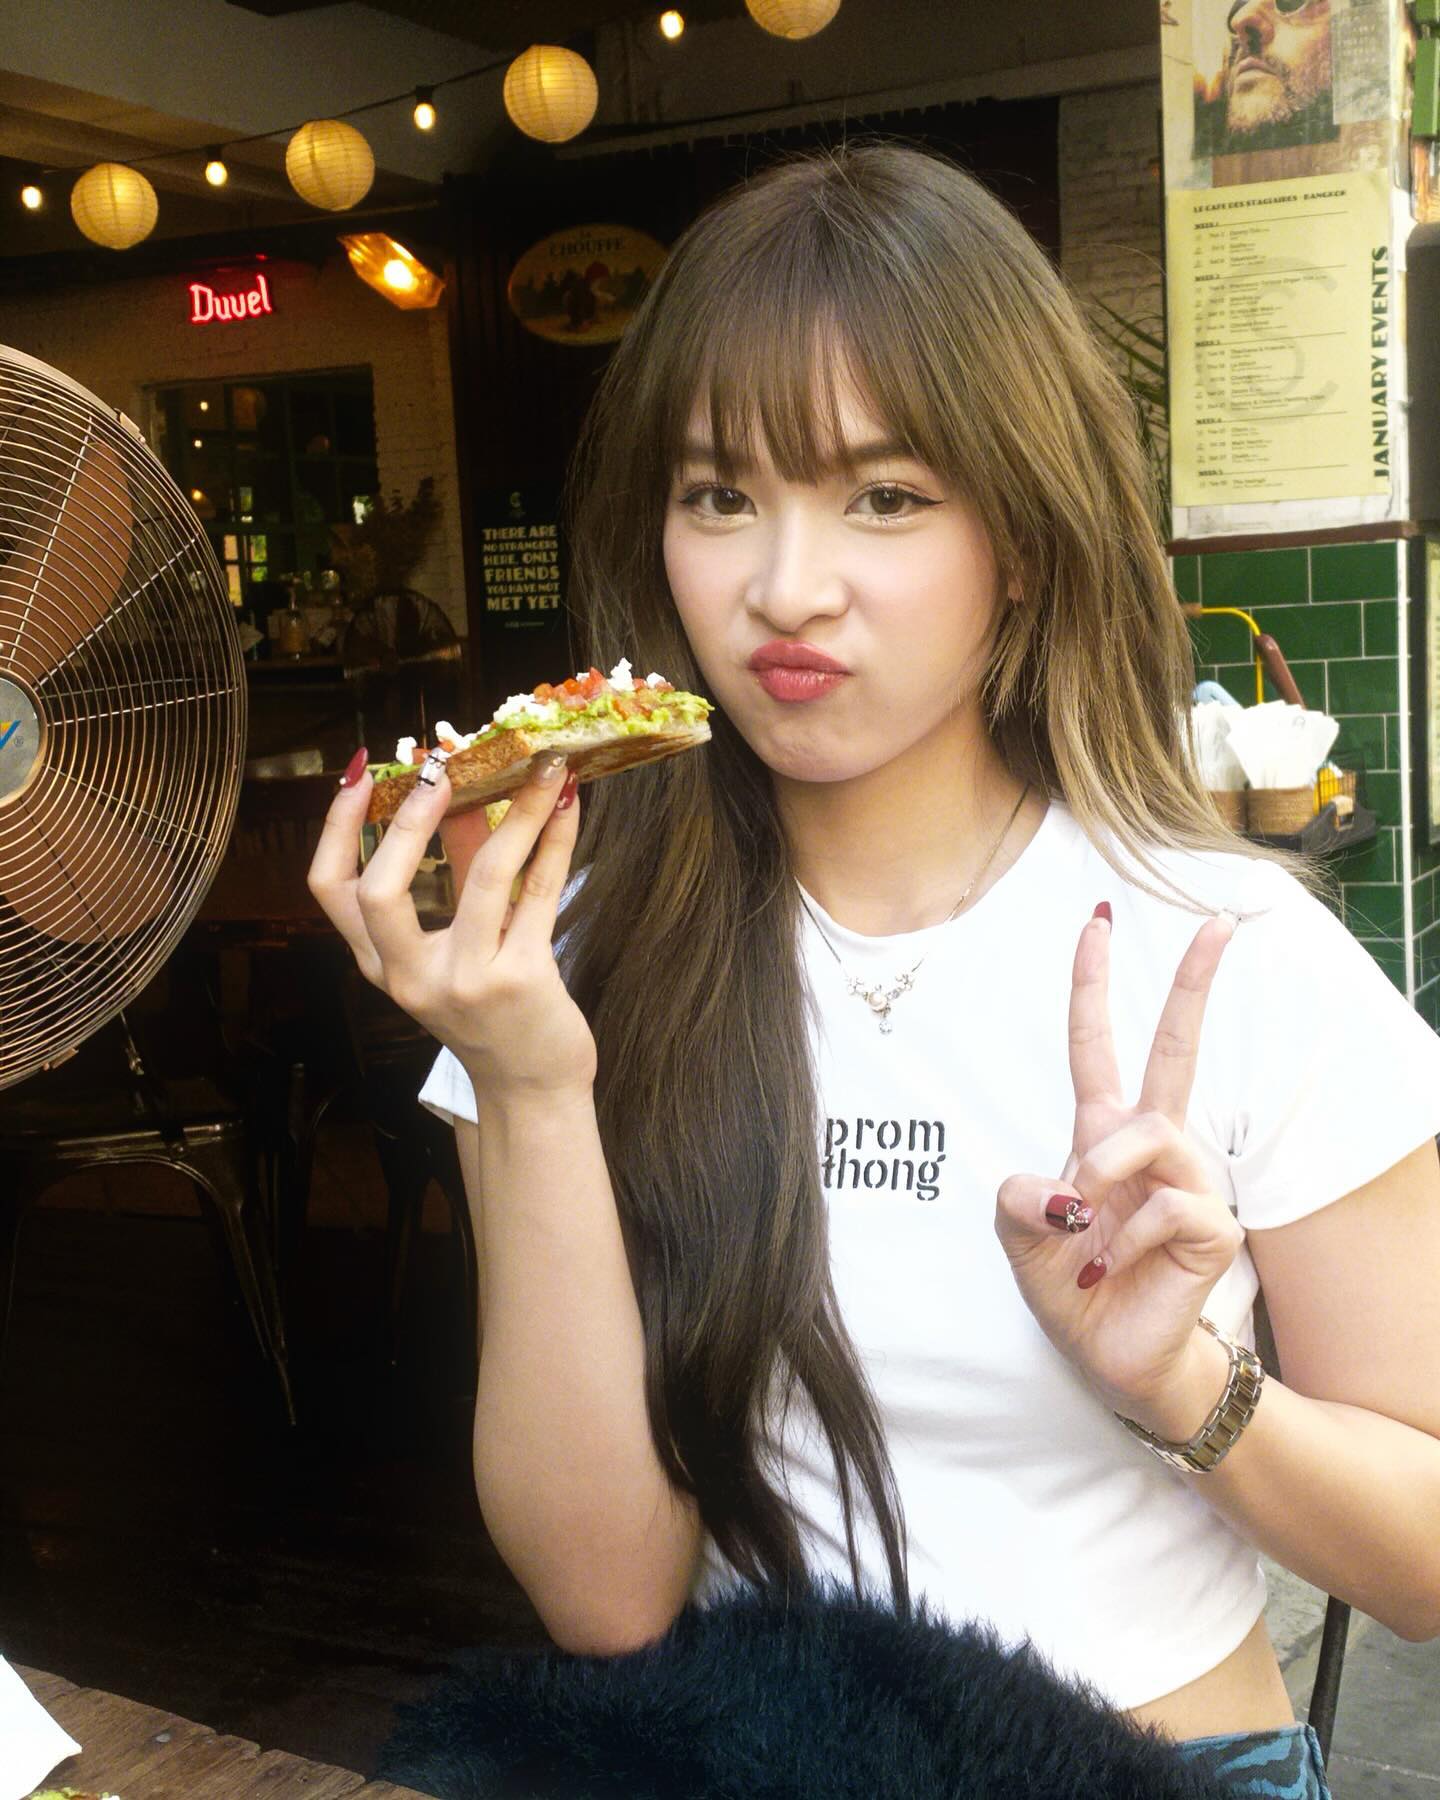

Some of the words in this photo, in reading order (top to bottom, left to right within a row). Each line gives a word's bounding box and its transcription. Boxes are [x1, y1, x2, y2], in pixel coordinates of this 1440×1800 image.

[1228, 199, 1245, 209] DES
[1246, 194, 1298, 208] STAGIAIRES
[189, 275, 272, 323] Duvel
[1371, 245, 1389, 348] EVENTS
[1371, 355, 1390, 480] JANUARY
[483, 527, 526, 540] THERE
[529, 525, 557, 537] ARE
[484, 543, 497, 552] NO
[500, 541, 558, 551] STRANGERS
[522, 552, 558, 564] ONLY
[485, 566, 560, 581] FRIENDS
[487, 585, 507, 594] YOU
[509, 584, 536, 593] HAVE
[539, 582, 560, 592] NOT
[487, 597, 521, 610] MET
[527, 595, 560, 609] YET
[825, 1119, 945, 1155] prom
[822, 1147, 947, 1201] thong
